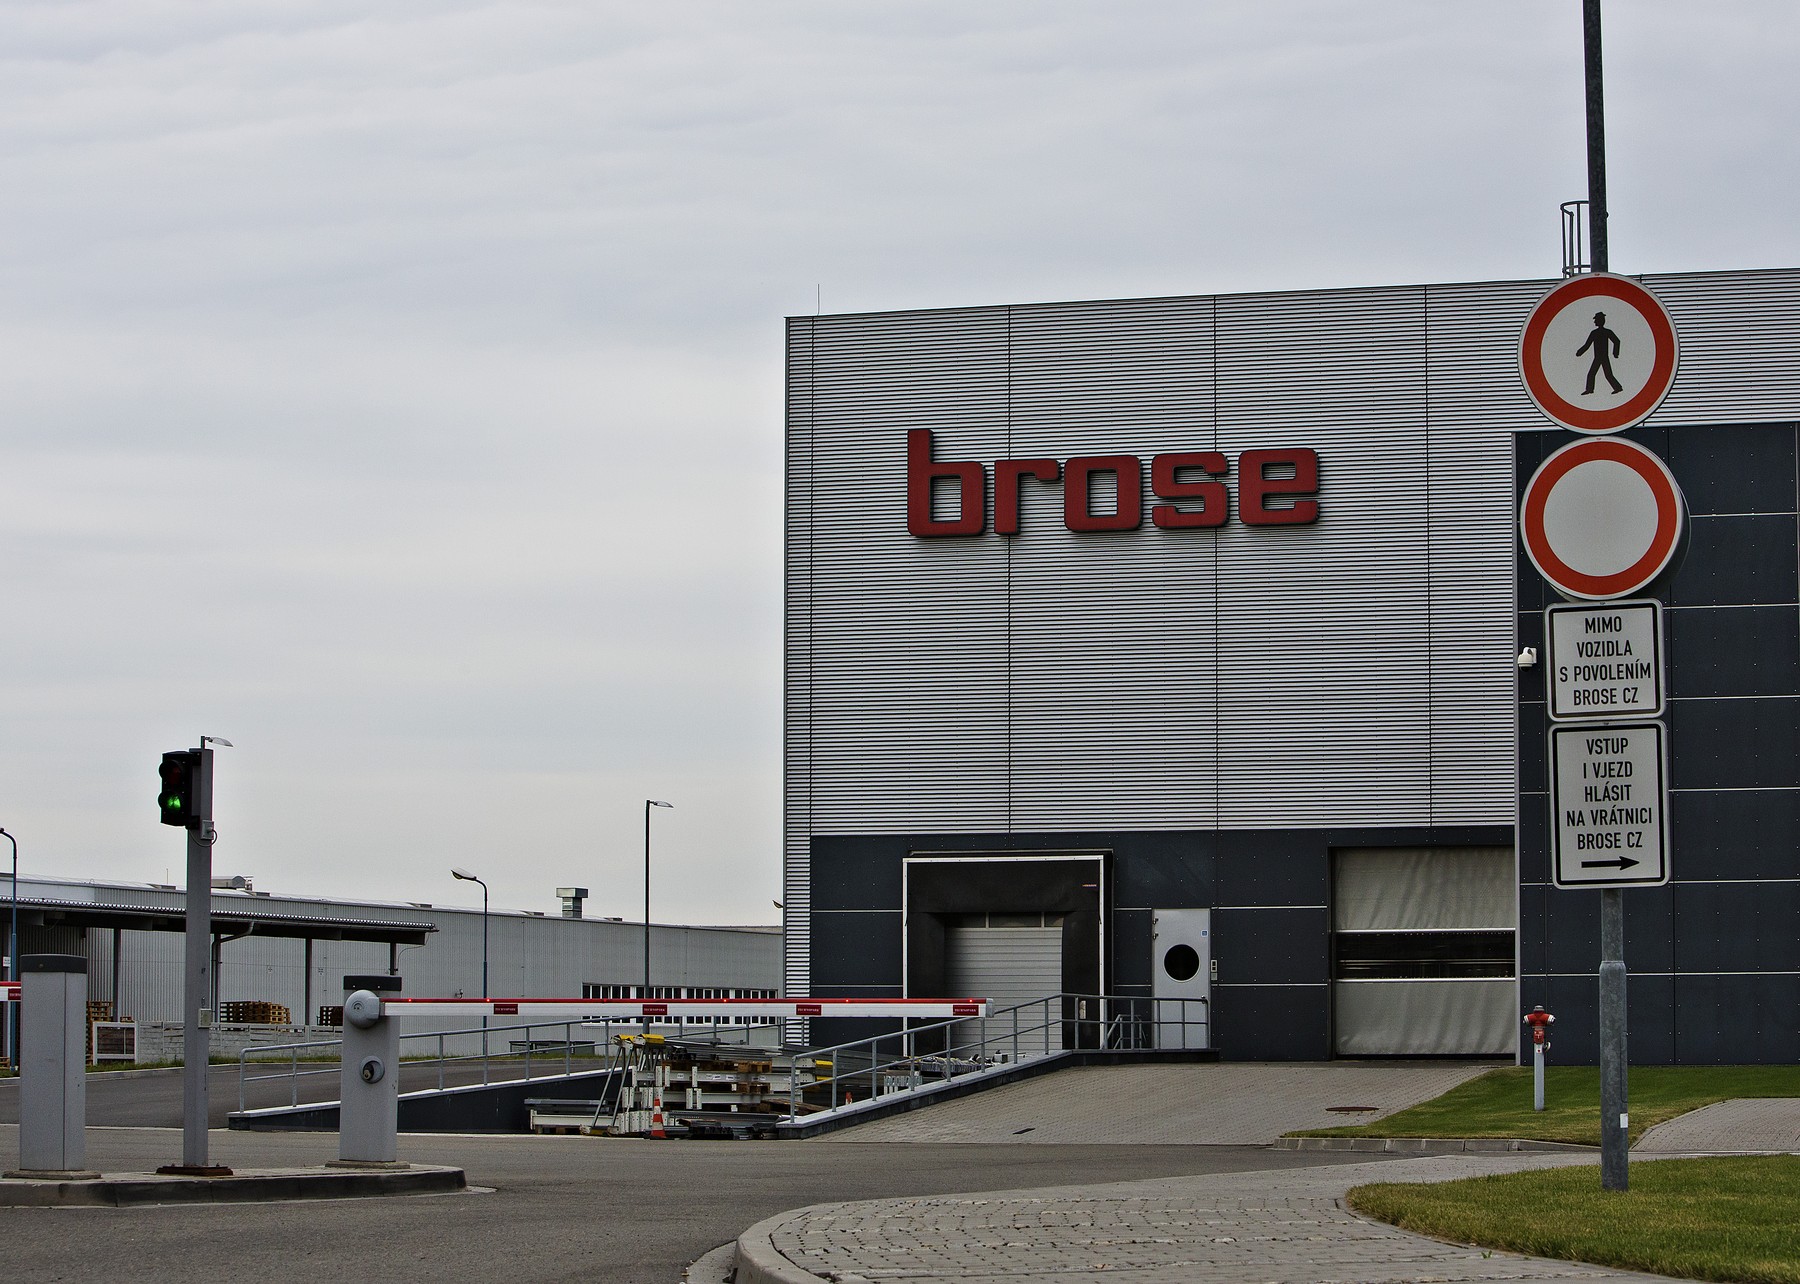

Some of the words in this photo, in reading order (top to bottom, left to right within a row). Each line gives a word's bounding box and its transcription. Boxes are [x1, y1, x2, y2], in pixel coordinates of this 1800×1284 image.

[907, 429, 1320, 537] brose
[1585, 616, 1622, 634] MIMO
[1576, 640, 1633, 658] VOZIDLA
[1559, 666, 1568, 682] S
[1574, 659, 1651, 681] POVOLENÍM
[1573, 688, 1617, 706] BROSE
[1622, 687, 1638, 704] CZ
[1586, 738, 1628, 755] VSTUP
[1583, 763, 1587, 779] I
[1592, 761, 1633, 778] VJEZD
[1584, 781, 1632, 802] HLÁSIT
[1566, 810, 1585, 827] NA
[1590, 805, 1652, 826] VRÁTNICI
[1577, 832, 1621, 850] BROSE
[1627, 831, 1643, 848] CZ
